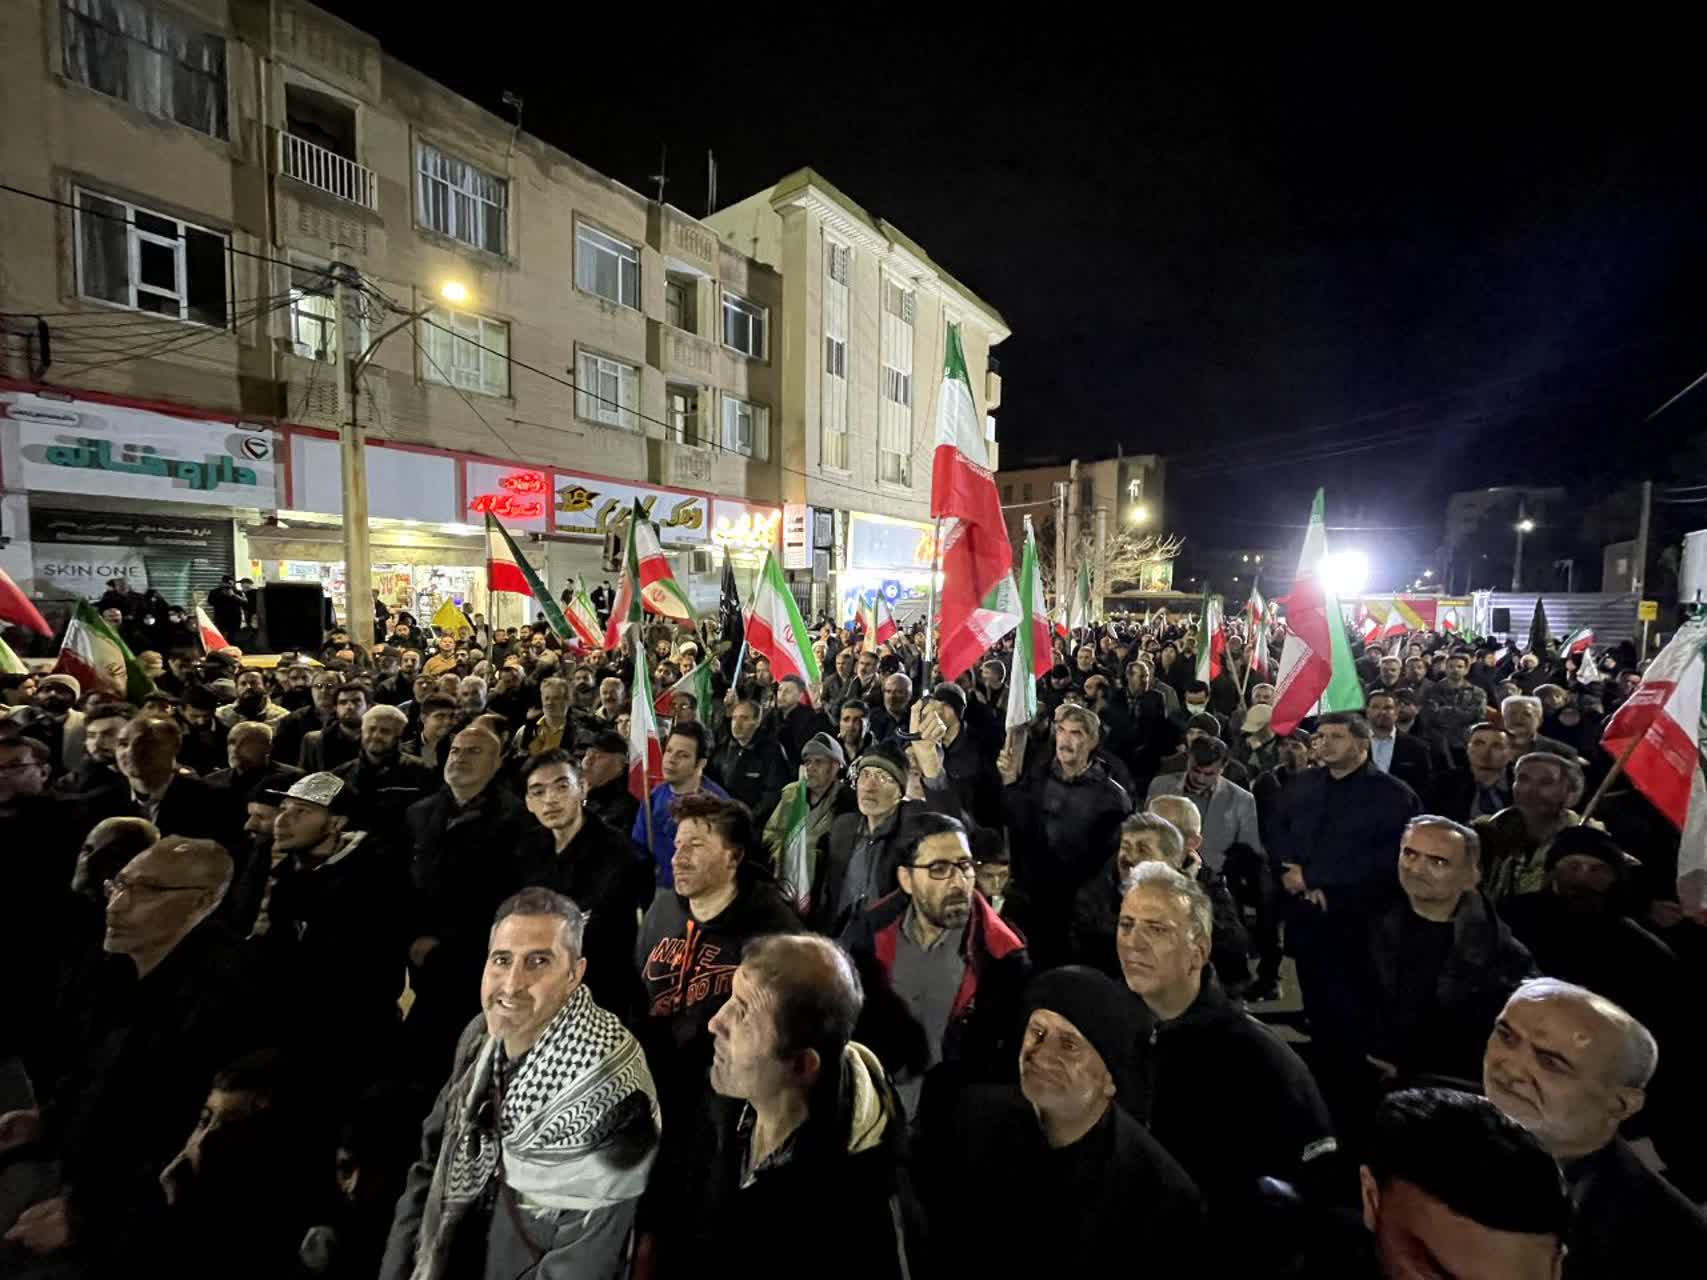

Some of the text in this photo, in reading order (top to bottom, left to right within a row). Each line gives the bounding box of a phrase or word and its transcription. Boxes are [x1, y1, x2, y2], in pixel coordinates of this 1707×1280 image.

[47, 437, 257, 491] داروخانه
[43, 563, 142, 577] SKIN ONE
